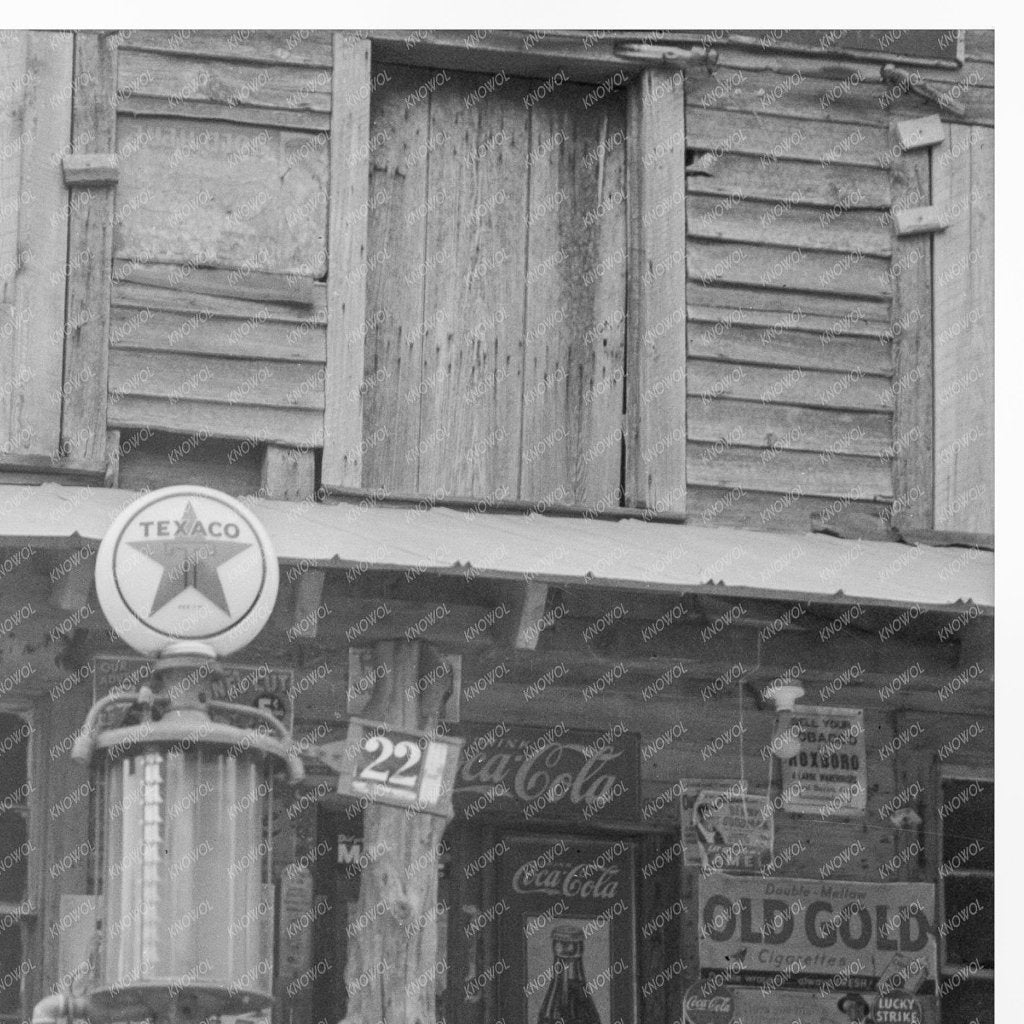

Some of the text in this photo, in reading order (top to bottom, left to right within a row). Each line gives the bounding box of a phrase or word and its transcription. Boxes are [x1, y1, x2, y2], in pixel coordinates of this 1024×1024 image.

[139, 520, 241, 539] TEXACO
[797, 731, 858, 746] OBACCO
[360, 735, 422, 787] 22
[703, 894, 929, 953] OLD GOLD
[758, 949, 847, 969] Cigarettes
[878, 998, 915, 1009] LUCKY
[876, 1010, 917, 1022] STRIKE
